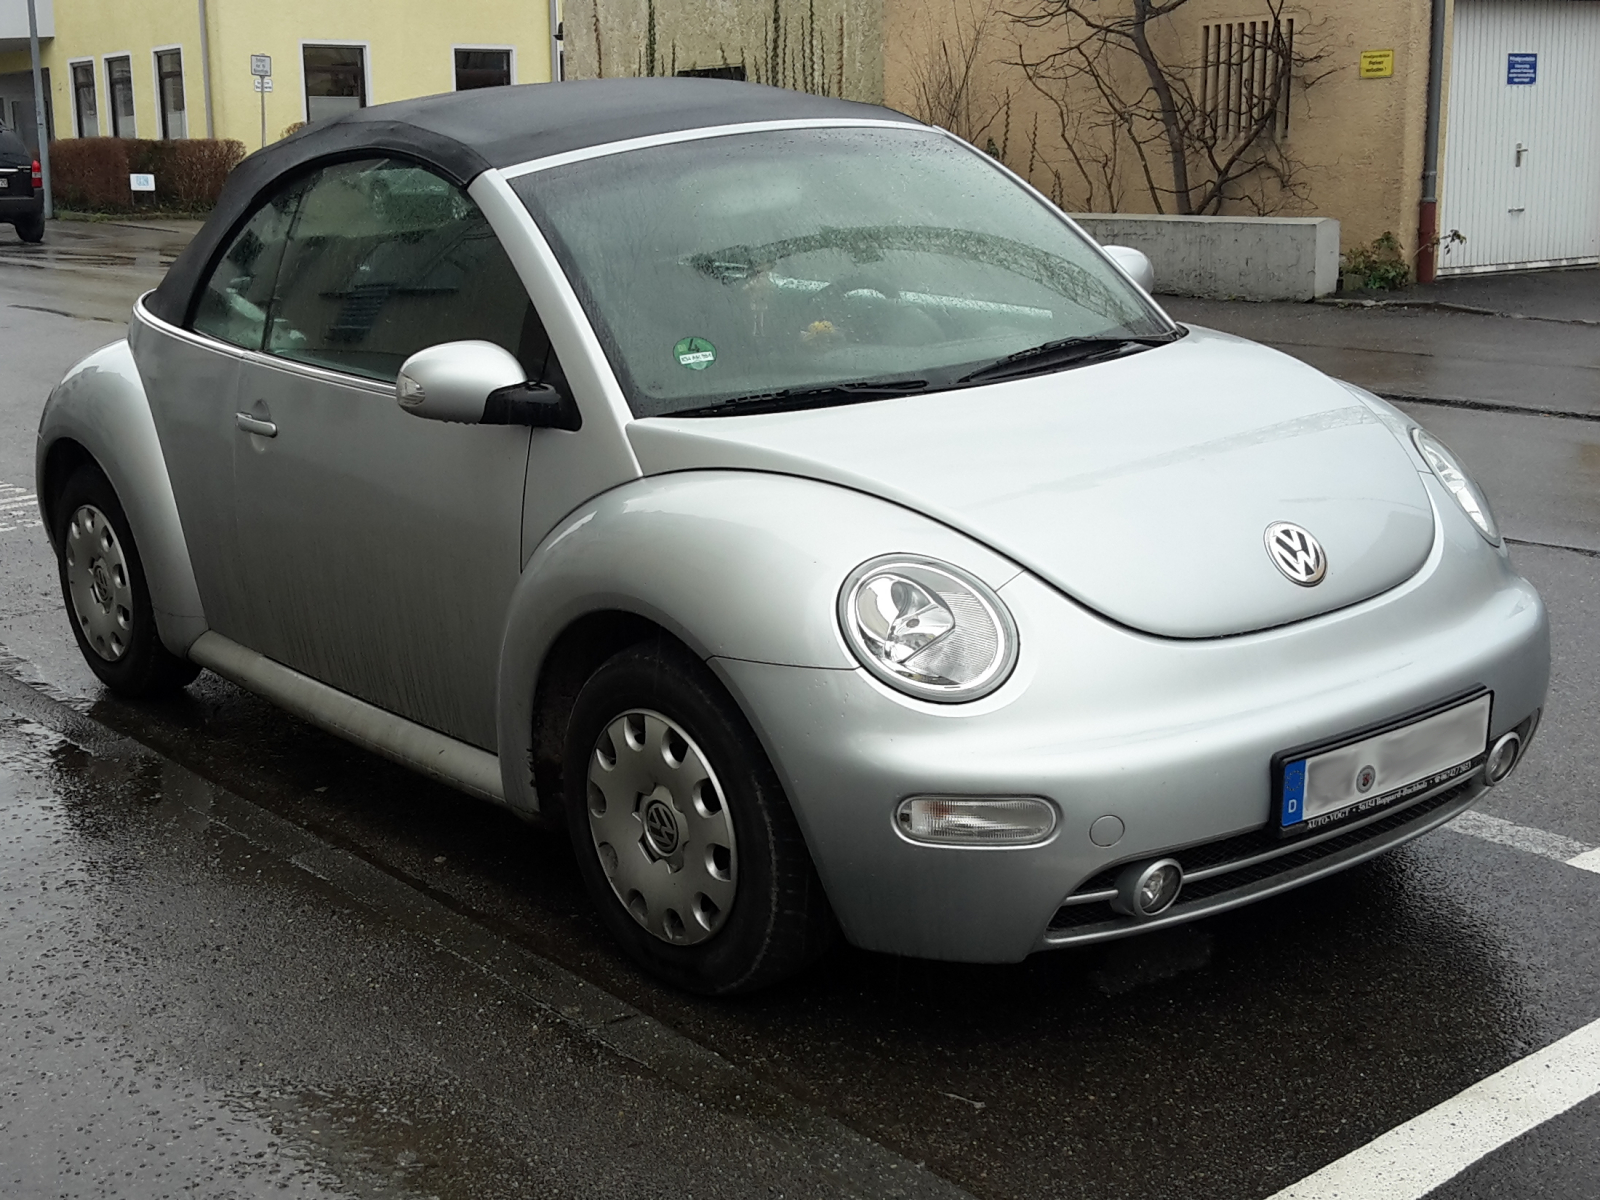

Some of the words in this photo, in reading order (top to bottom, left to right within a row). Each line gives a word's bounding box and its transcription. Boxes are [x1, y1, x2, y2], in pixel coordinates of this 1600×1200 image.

[688, 338, 700, 352] 4
[1267, 524, 1325, 583] VW
[1288, 799, 1297, 813] D
